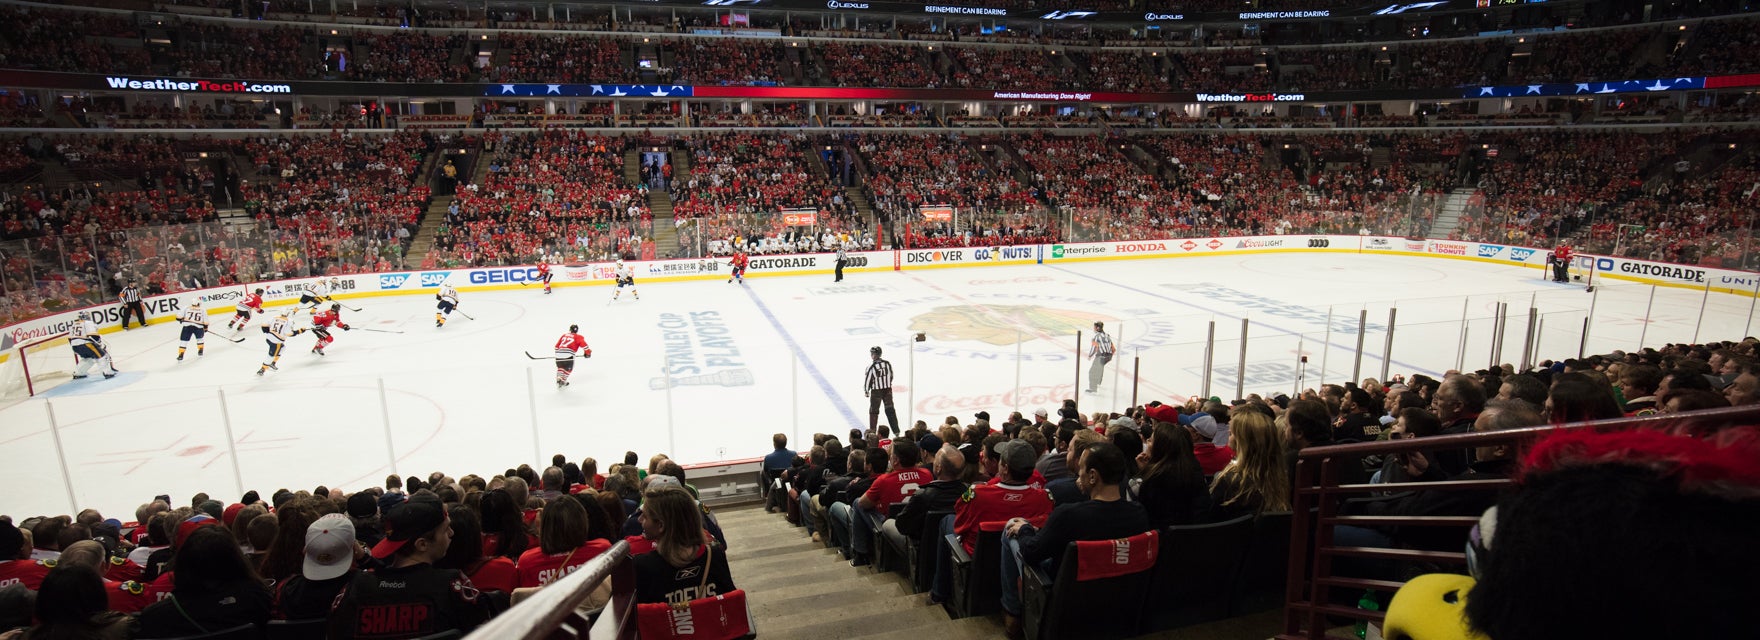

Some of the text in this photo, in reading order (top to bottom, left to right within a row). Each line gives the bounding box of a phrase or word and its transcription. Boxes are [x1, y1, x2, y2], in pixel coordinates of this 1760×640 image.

[1021, 92, 1059, 100] Manufacturing
[1056, 245, 1105, 255] enterprise
[1115, 243, 1167, 252] HONDA
[1438, 243, 1468, 251] DUNKIN'
[1438, 248, 1466, 256] DONUTS
[1478, 245, 1499, 256] SAP
[907, 250, 963, 263] DISCOVER
[974, 249, 989, 260] GO
[1003, 247, 1032, 259] NUTS!
[1510, 249, 1530, 260] SAP
[750, 257, 816, 270] GATORADE
[469, 268, 544, 284] GEICO
[1620, 262, 1706, 283] GATORADE
[341, 280, 355, 290] 88
[380, 276, 405, 287] SAP
[421, 273, 444, 287] SAP
[187, 310, 202, 322] 76
[658, 312, 689, 329] CUP
[48, 318, 80, 335] LIGH
[688, 310, 746, 367] PLAYOFFS
[661, 329, 701, 375] STANLEY
[898, 471, 920, 481] KEITH
[1115, 540, 1130, 565] ONE
[379, 581, 406, 589] Reebok
[361, 605, 428, 634] SHARP
